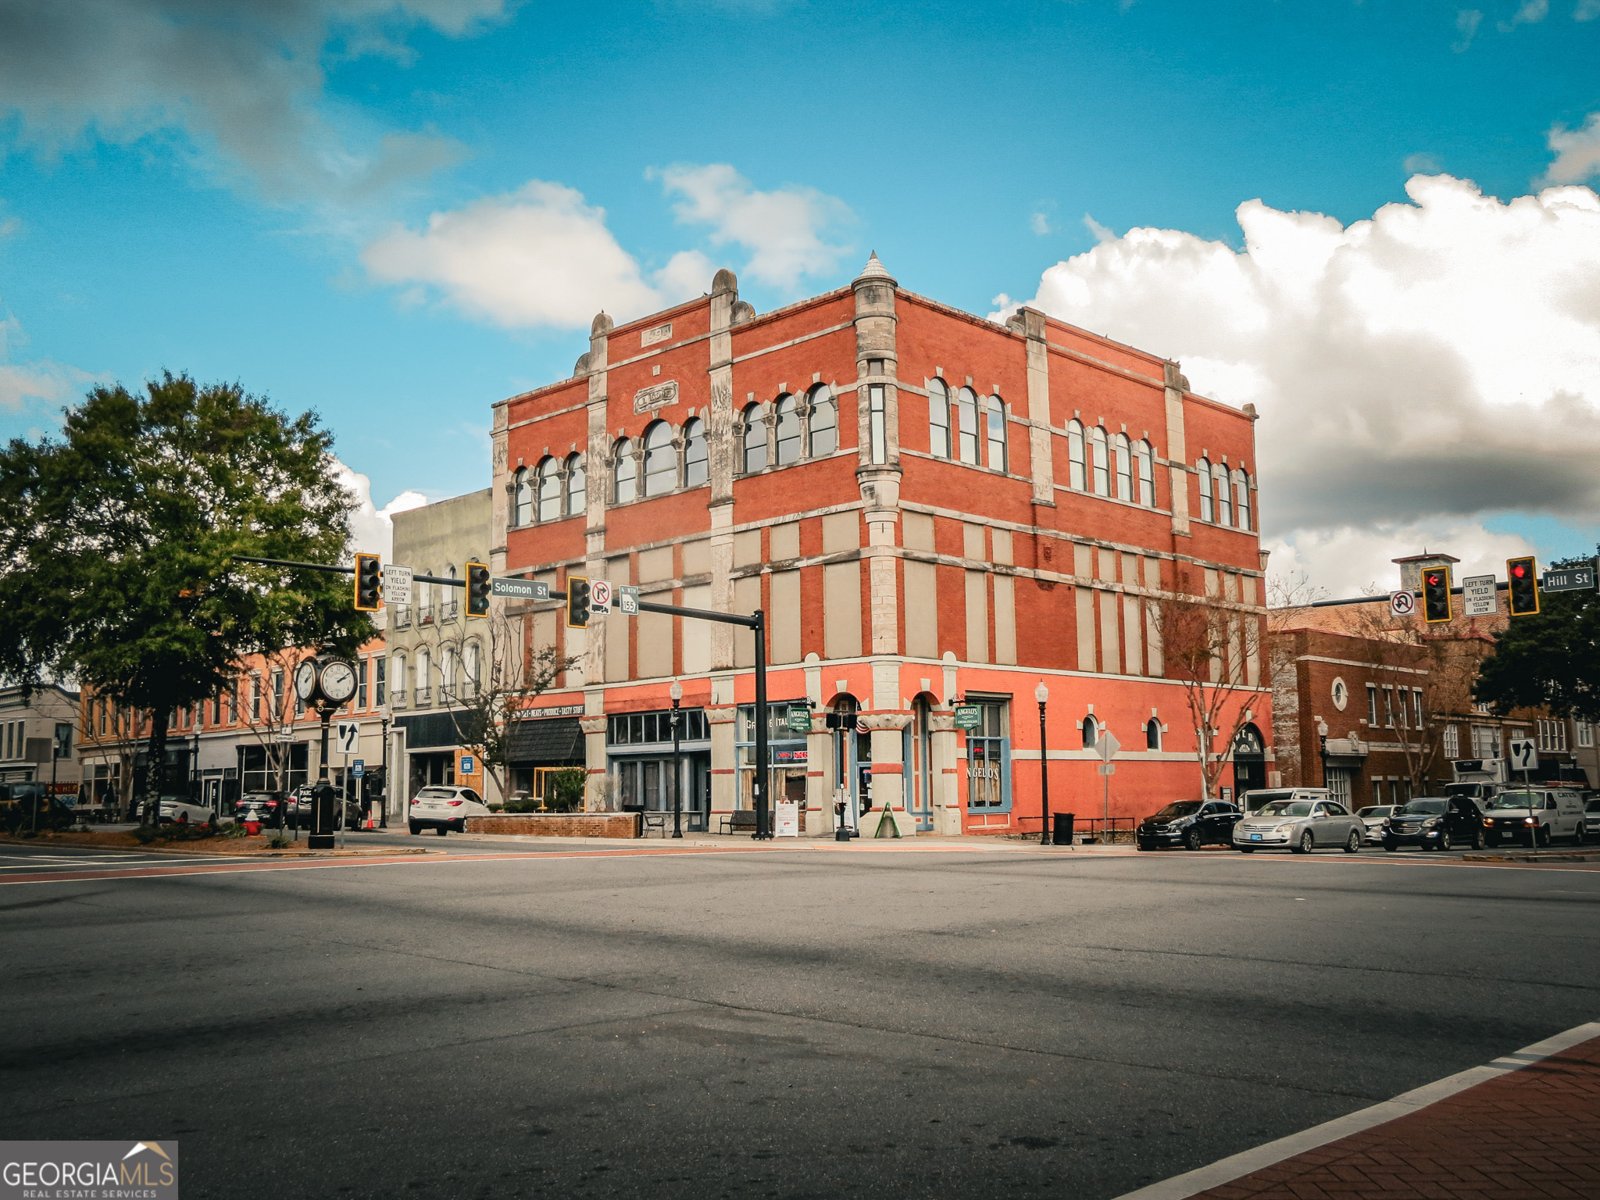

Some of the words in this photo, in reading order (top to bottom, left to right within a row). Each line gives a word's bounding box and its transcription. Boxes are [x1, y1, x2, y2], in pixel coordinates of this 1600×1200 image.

[1465, 580, 1478, 588] LEFT
[1547, 575, 1567, 587] Hill
[1575, 573, 1588, 584] St
[494, 582, 532, 595] Solomon
[537, 586, 547, 596] St
[1470, 587, 1489, 595] YIELD
[623, 600, 635, 610] 155
[966, 767, 999, 780] NGELO'S
